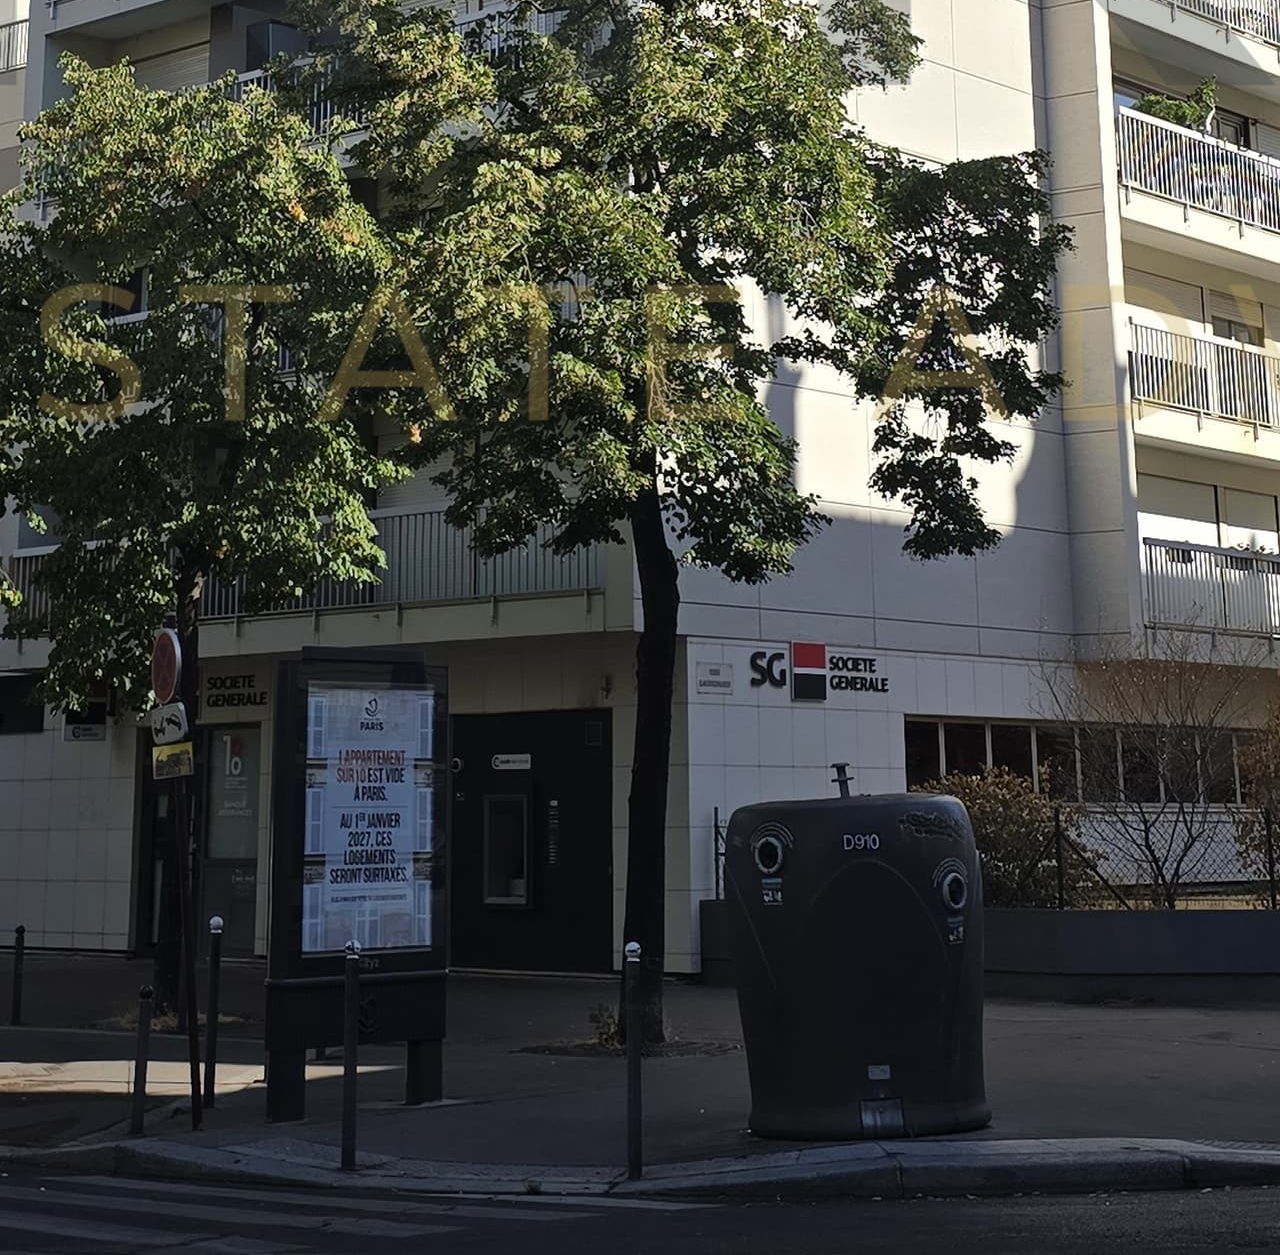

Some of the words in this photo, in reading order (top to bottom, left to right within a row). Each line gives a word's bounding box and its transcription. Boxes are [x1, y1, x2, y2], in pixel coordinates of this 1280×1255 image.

[750, 651, 787, 687] SG
[360, 722, 384, 731] PARIS
[344, 750, 406, 766] APPARTEMENT
[337, 768, 354, 783] SUR
[356, 768, 367, 783] 10
[368, 768, 383, 783] EST
[386, 768, 405, 783] VIDE
[354, 784, 360, 801] À
[361, 786, 388, 801] PARIS.
[340, 814, 353, 828] AU
[366, 813, 400, 828] JANVIER
[376, 832, 392, 846] CES
[843, 834, 880, 850] D910
[343, 849, 396, 865] LOGEMENTS
[330, 867, 362, 884] SERONT
[363, 864, 409, 883] SURTAXÉS.
